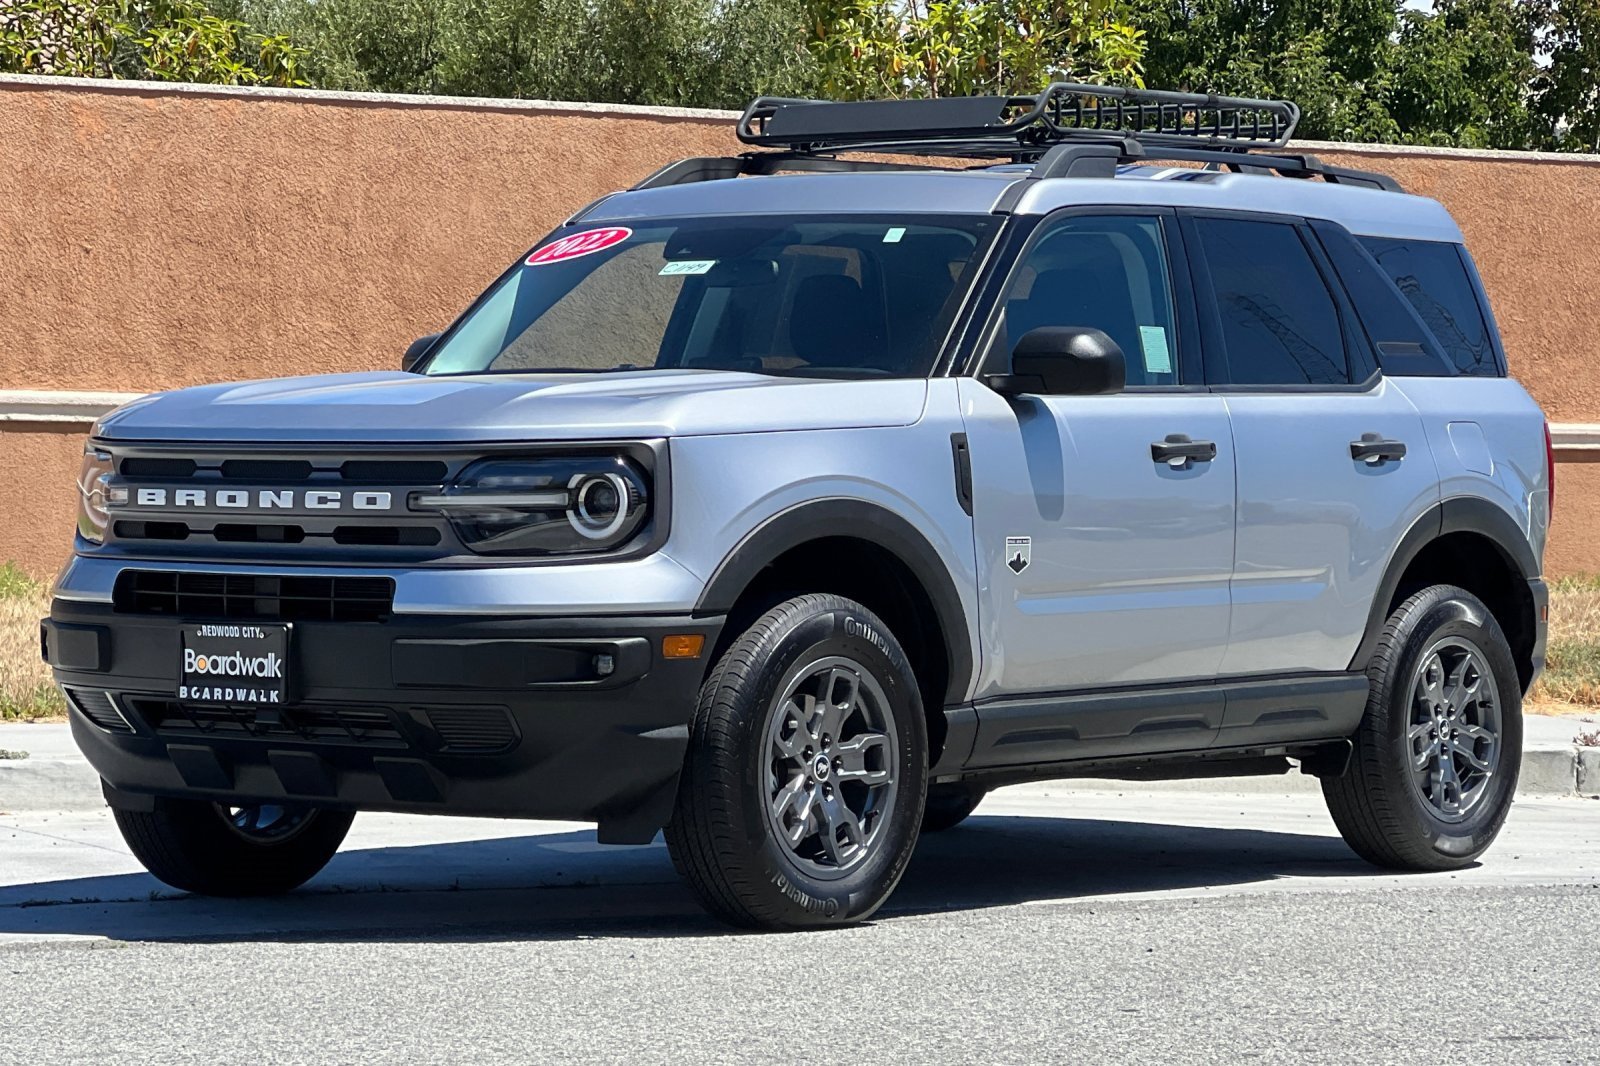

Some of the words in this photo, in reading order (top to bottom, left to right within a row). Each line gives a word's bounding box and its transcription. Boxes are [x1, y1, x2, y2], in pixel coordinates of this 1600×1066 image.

[534, 230, 618, 262] 2022
[137, 488, 391, 509] BRONCO
[202, 625, 239, 637] REDWOOD
[242, 627, 260, 638] CITY
[184, 648, 282, 678] Boardwalk
[180, 686, 279, 702] BOARDWALK
